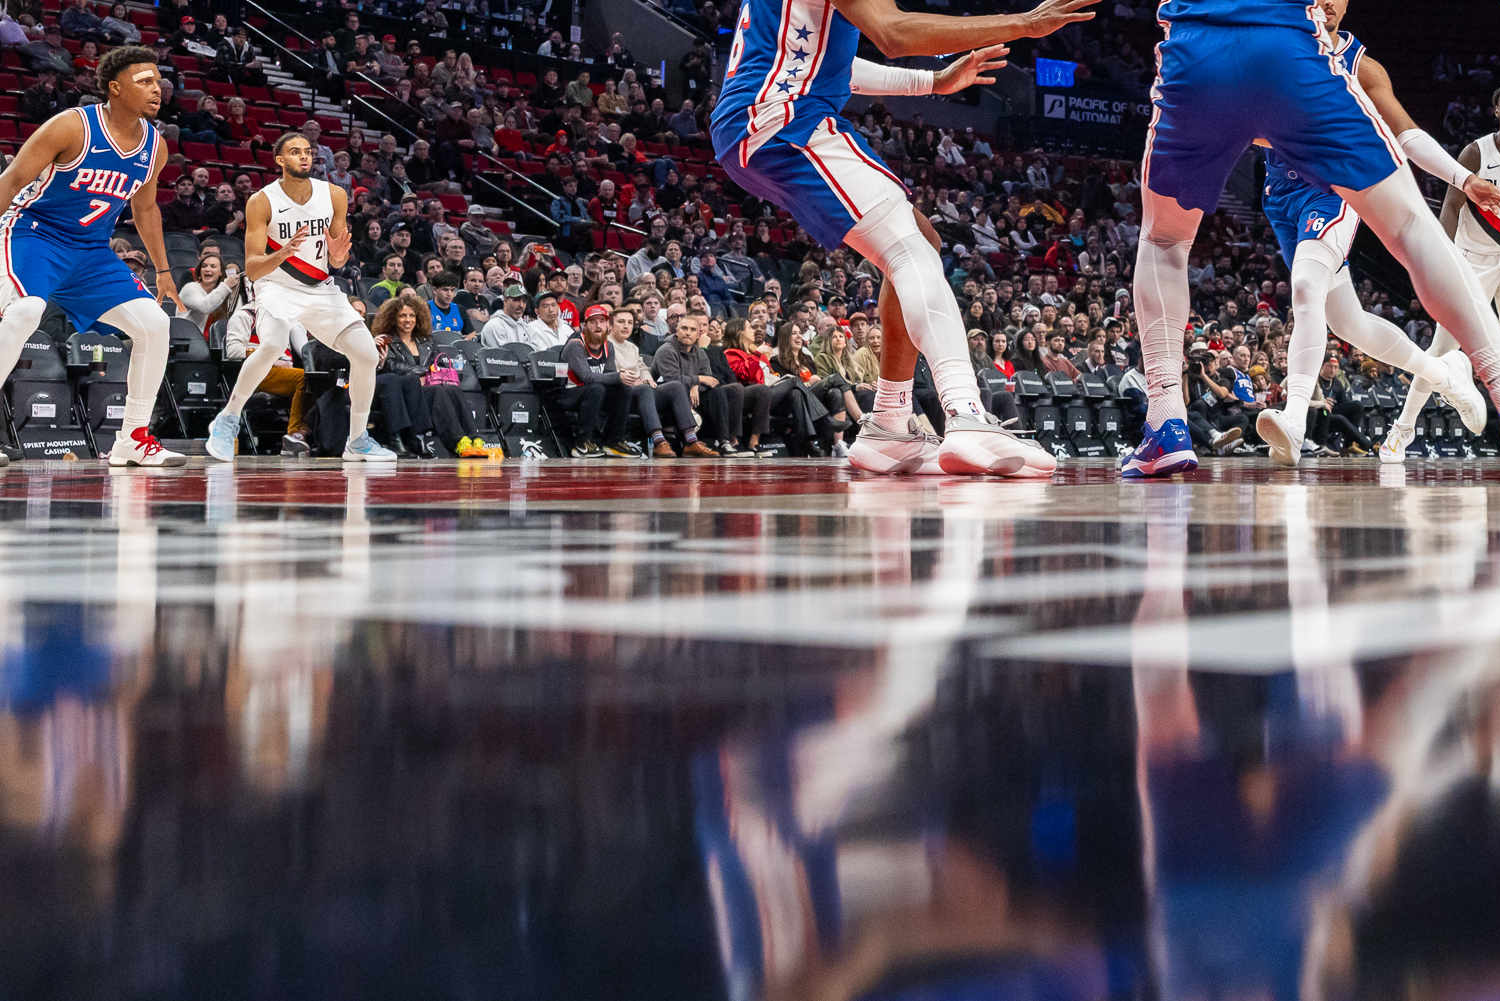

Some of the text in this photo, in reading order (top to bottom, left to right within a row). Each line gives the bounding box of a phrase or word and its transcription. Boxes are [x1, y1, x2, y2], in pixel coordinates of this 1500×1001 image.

[1069, 96, 1151, 116] PACIFIC OFCE
[79, 199, 111, 227] 7
[1304, 217, 1325, 233] 76
[44, 447, 71, 455] CASINO
[46, 440, 86, 448] MOUNTAIN
